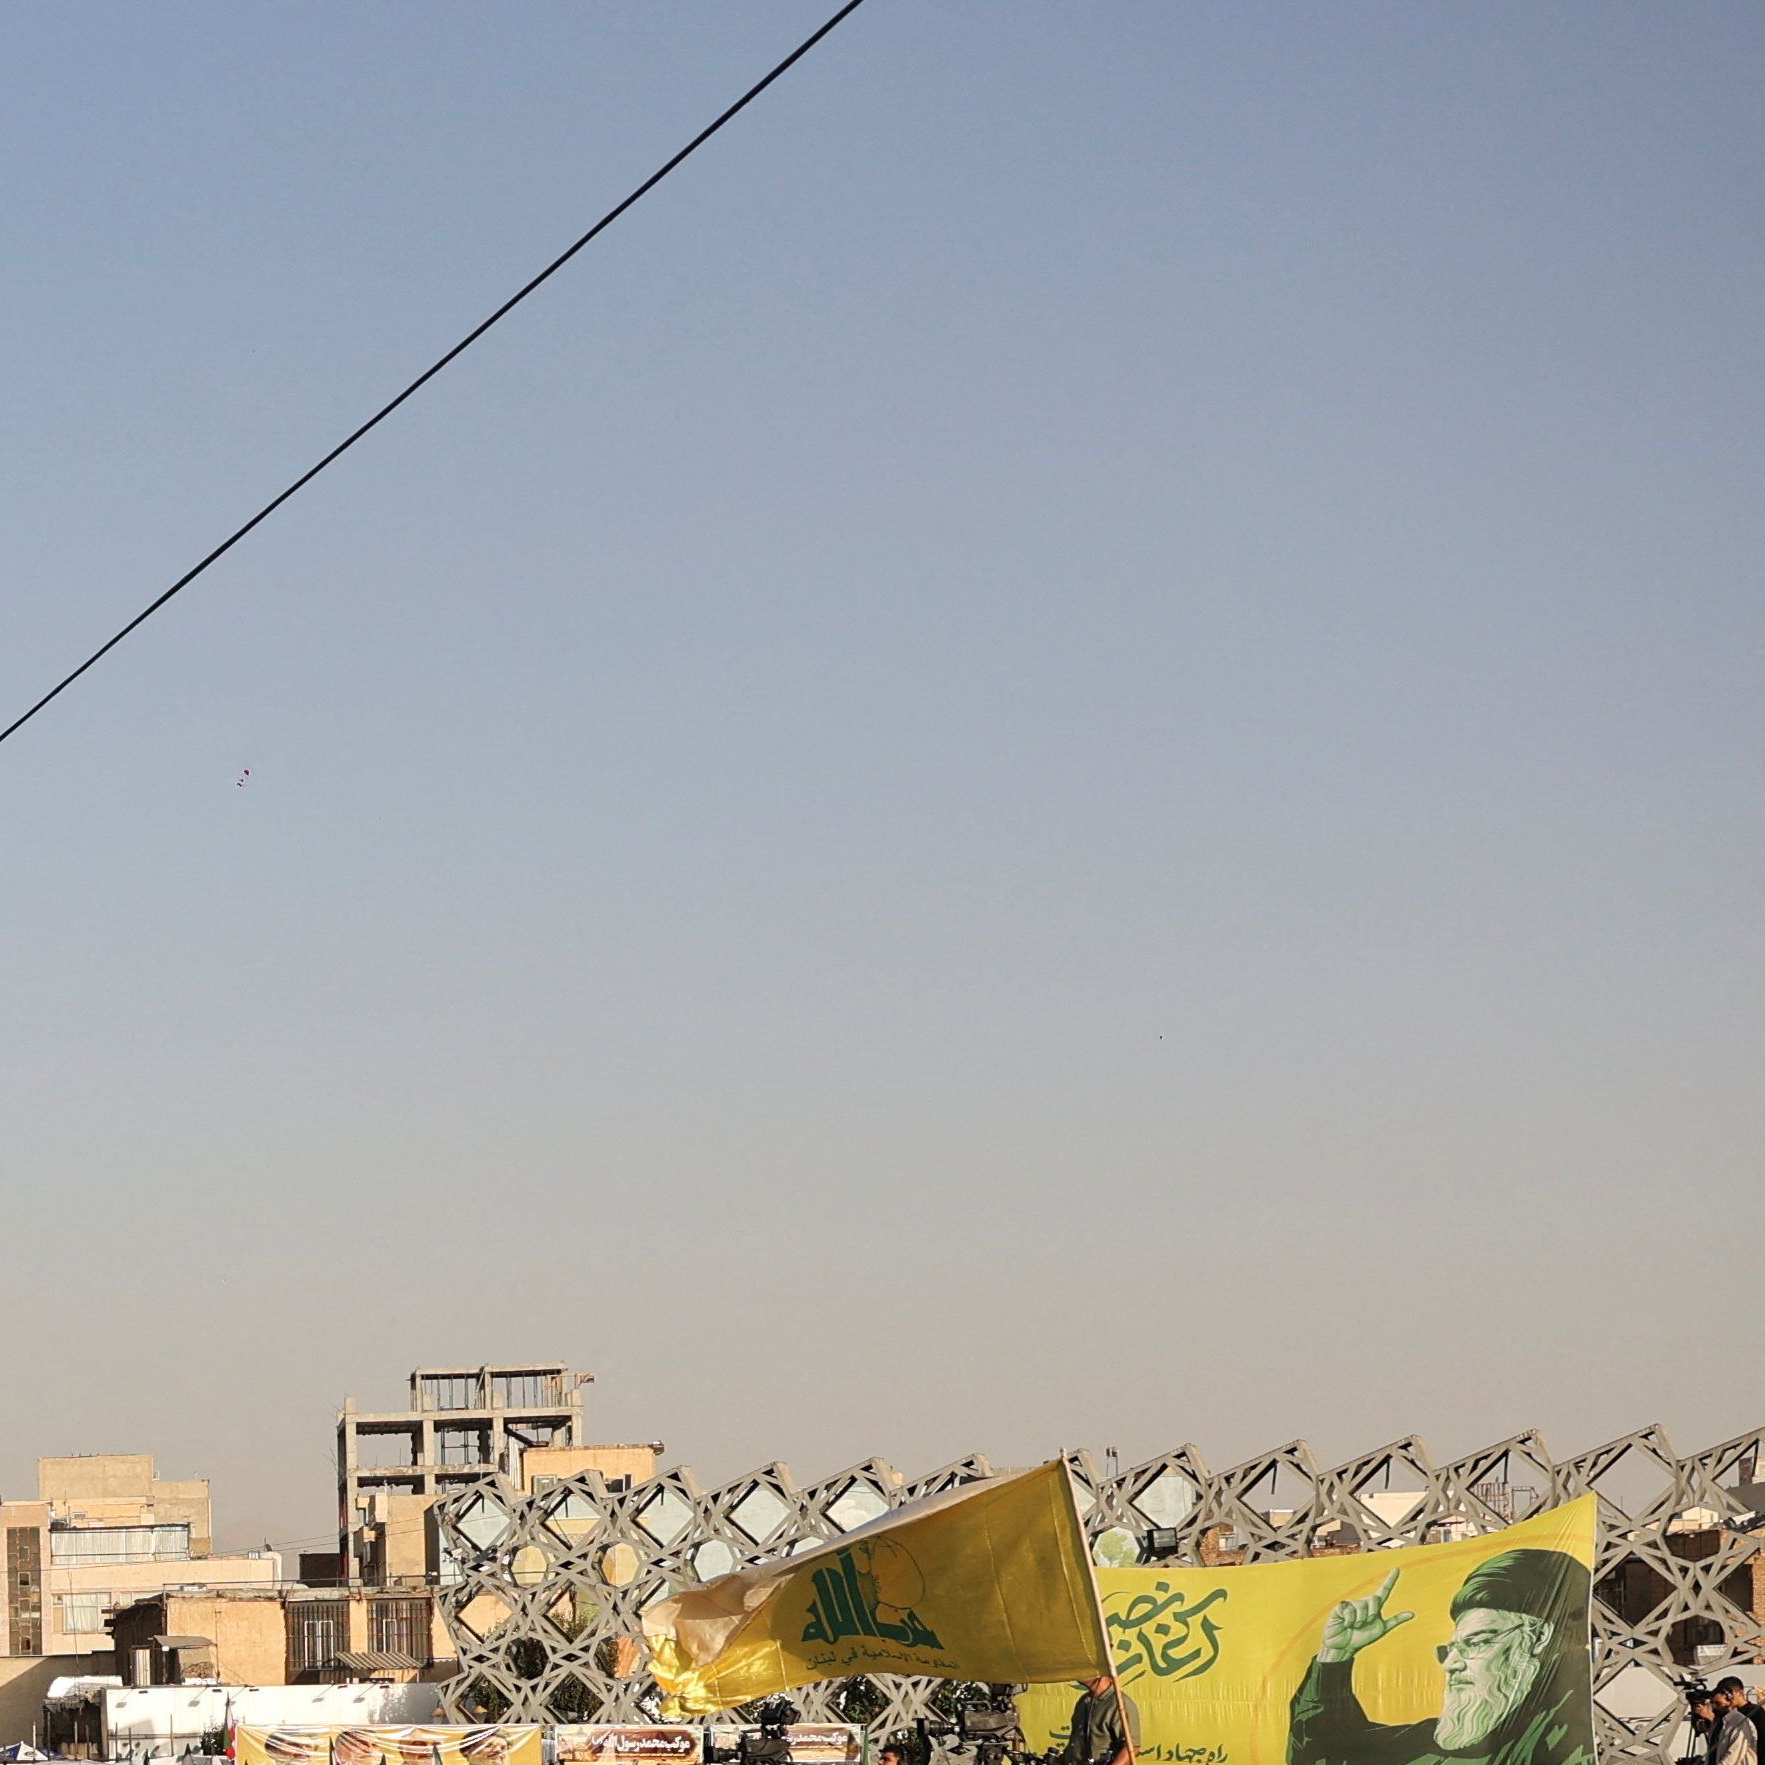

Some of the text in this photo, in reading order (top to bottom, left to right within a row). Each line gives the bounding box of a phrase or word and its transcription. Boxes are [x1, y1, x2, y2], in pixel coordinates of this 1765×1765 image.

[806, 1651, 837, 1670] لبنان
[617, 1735, 640, 1752] رسول
[639, 1738, 665, 1748] محمد
[1163, 1743, 1208, 1764] جهاد
[1207, 1743, 1228, 1764] راه
